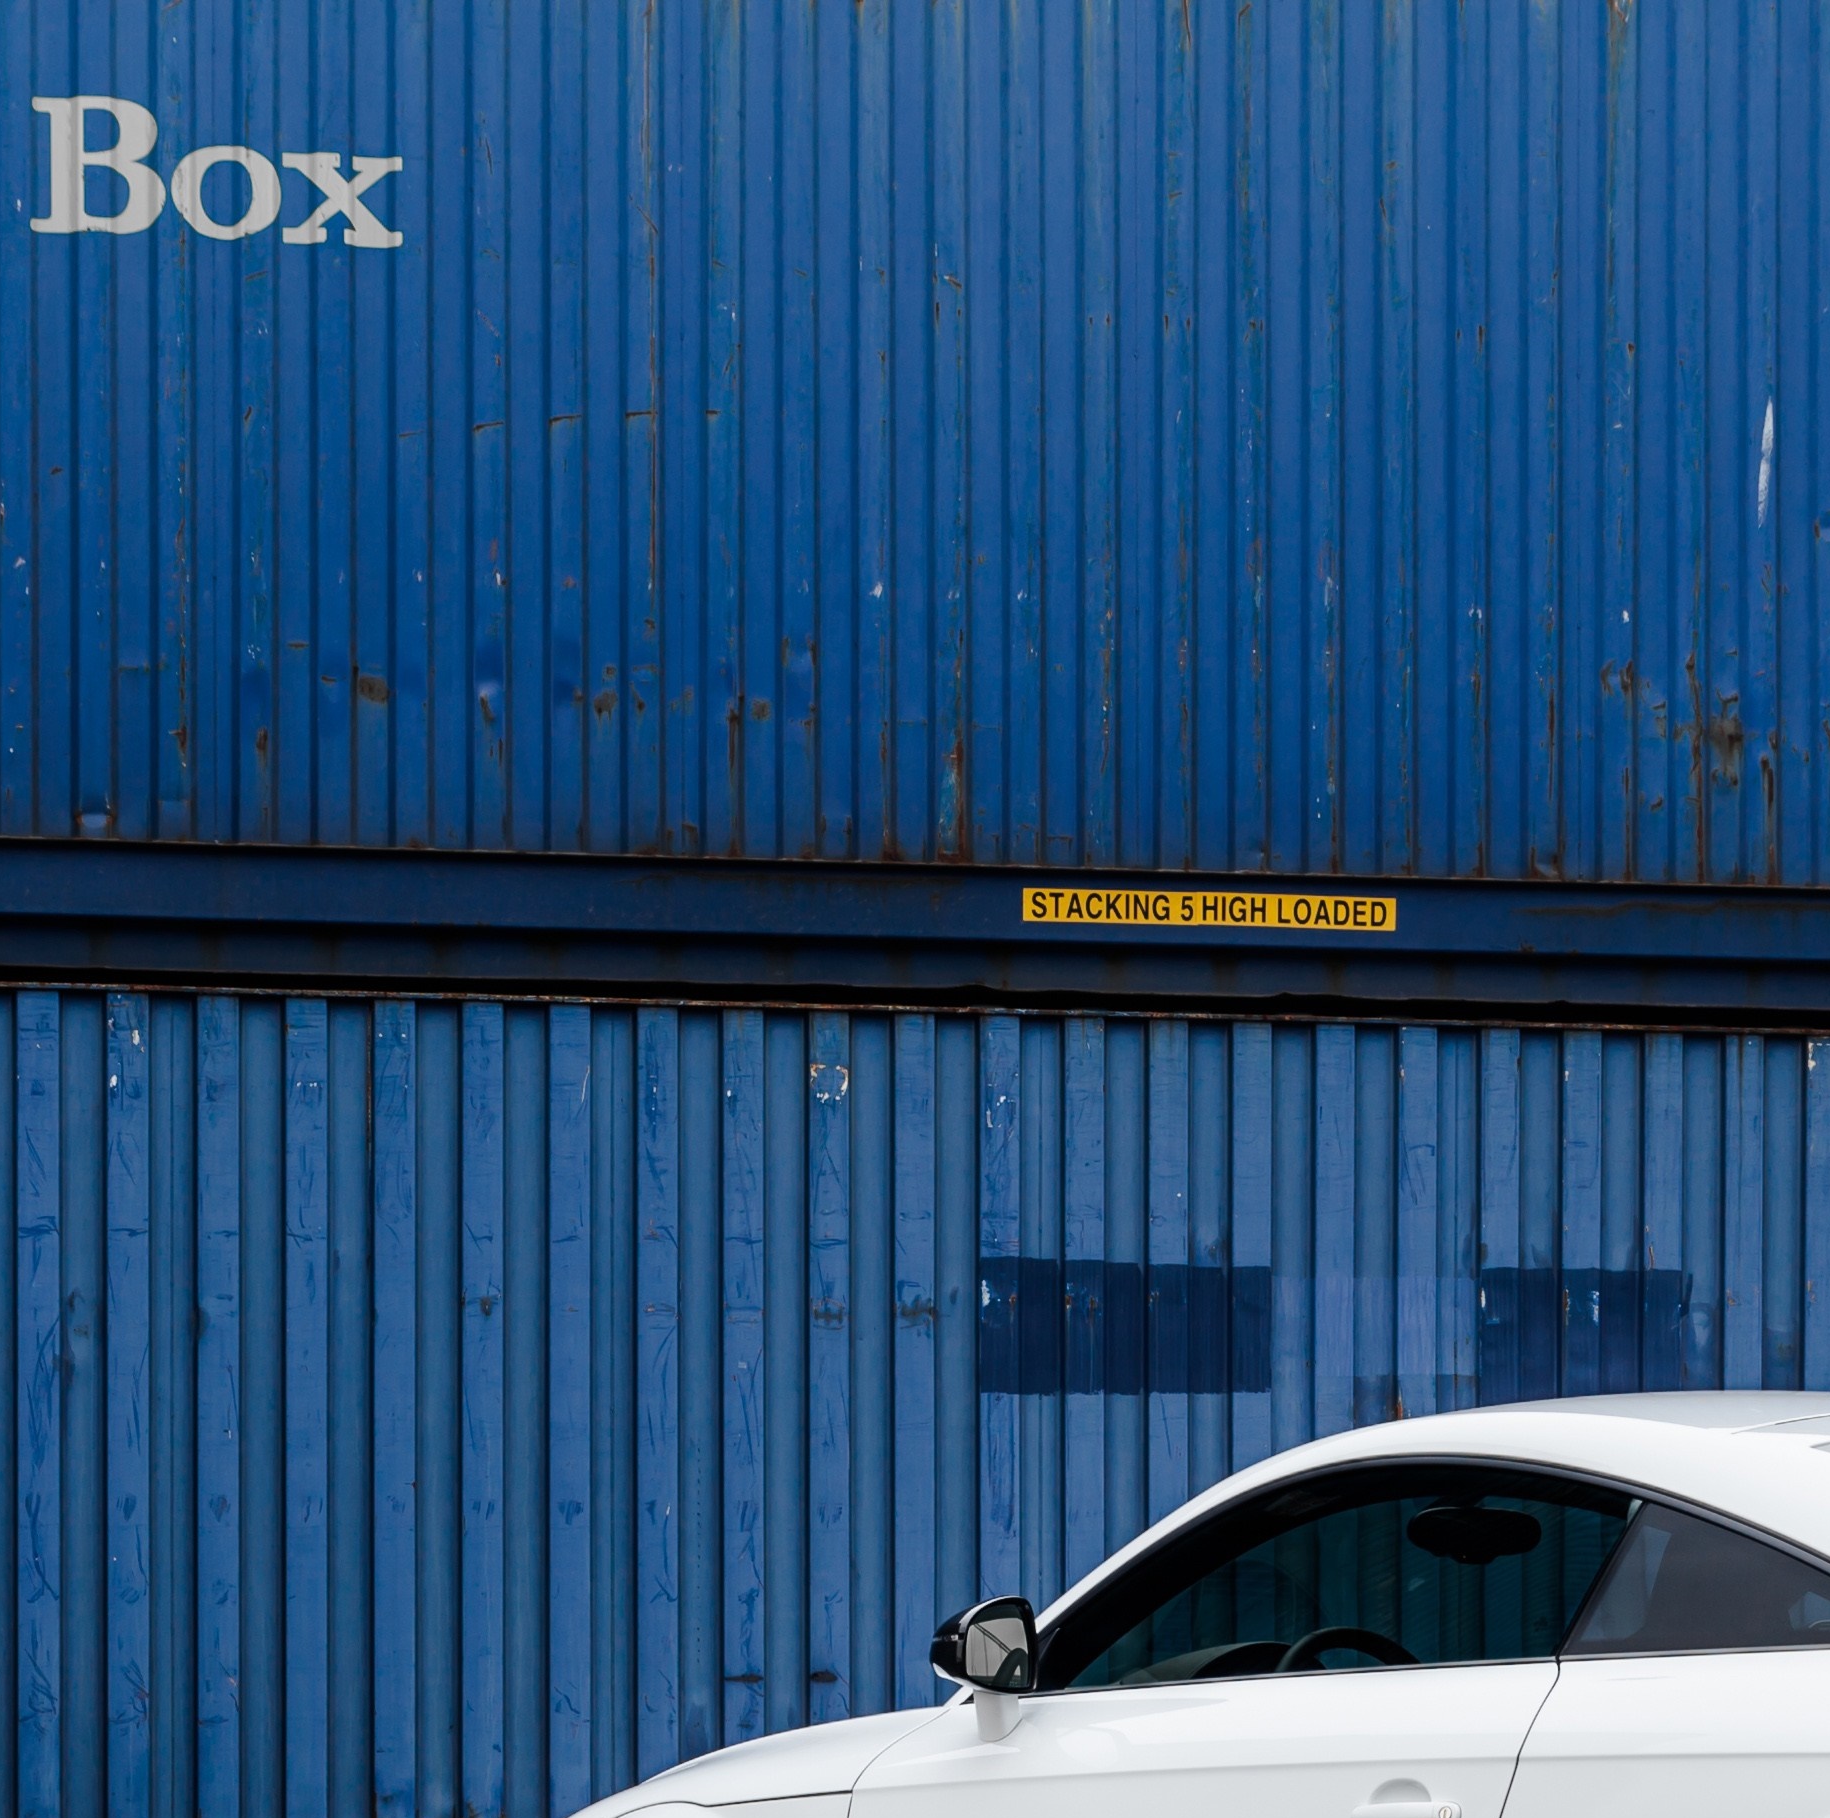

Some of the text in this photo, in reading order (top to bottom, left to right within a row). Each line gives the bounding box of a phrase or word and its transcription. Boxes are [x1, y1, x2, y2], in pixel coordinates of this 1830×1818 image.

[29, 93, 404, 250] Box
[1030, 891, 1388, 928] STACKING 5 HIGH LOADED
